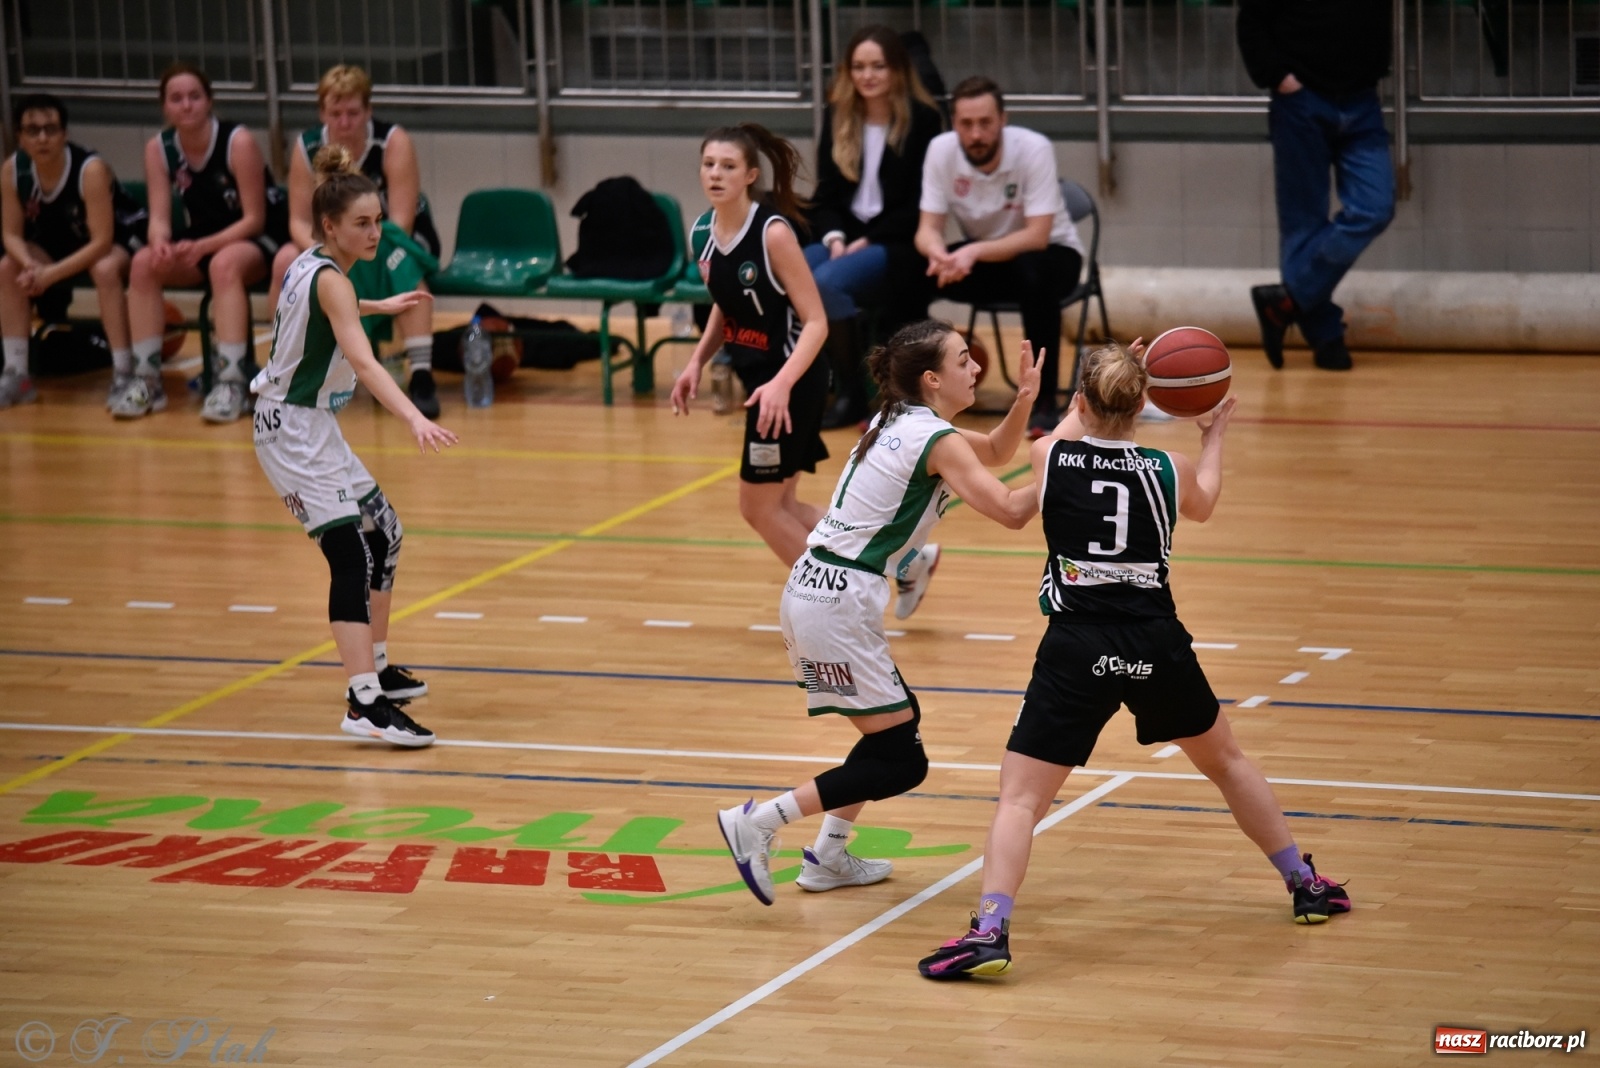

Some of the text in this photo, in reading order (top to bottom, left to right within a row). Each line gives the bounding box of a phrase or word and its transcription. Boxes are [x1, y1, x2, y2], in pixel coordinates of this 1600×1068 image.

[743, 288, 764, 316] 7
[254, 408, 281, 433] ANS
[1057, 452, 1086, 469] RKK
[1088, 480, 1129, 556] 3
[1108, 655, 1153, 676] Clevis
[828, 832, 848, 840] adid
